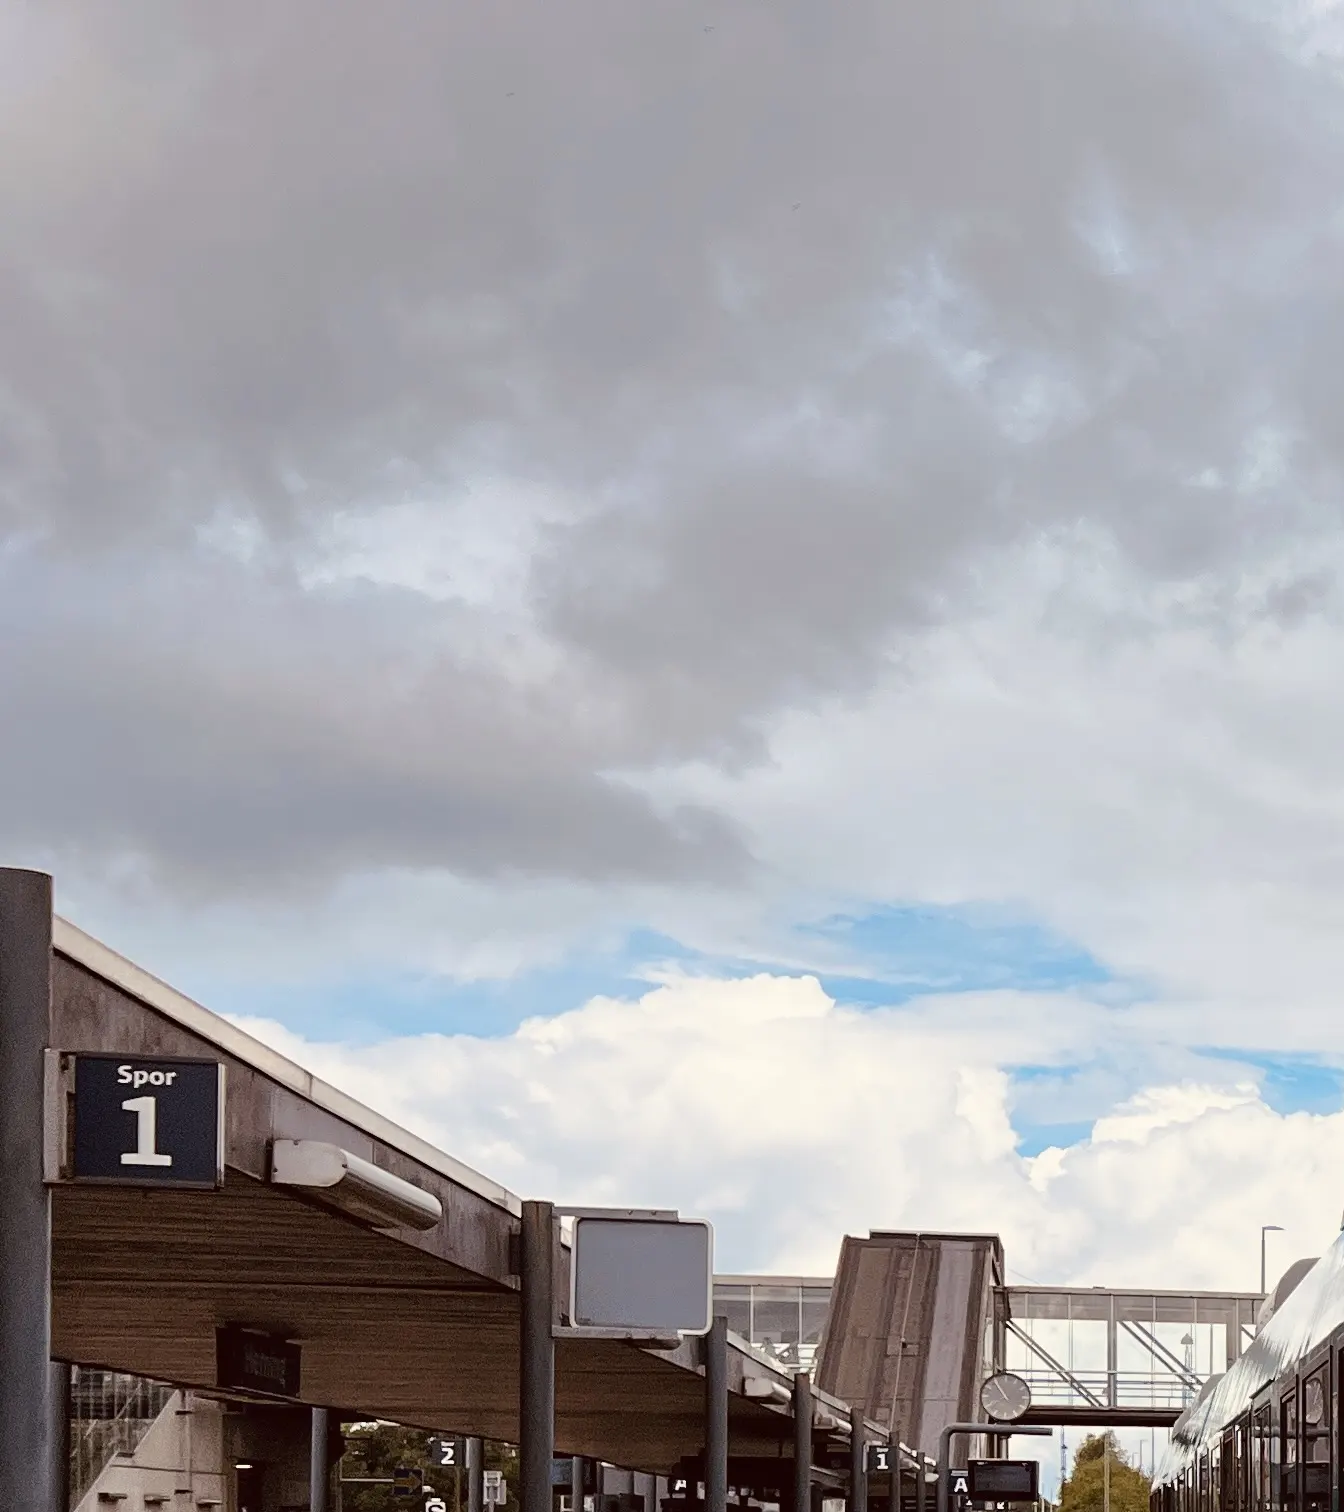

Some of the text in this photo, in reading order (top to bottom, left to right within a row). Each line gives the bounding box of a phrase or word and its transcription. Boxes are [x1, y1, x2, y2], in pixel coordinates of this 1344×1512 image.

[117, 1065, 178, 1089] Spor
[120, 1096, 173, 1167] 1
[441, 1447, 455, 1465] 2
[876, 1453, 889, 1470] 1
[954, 1477, 968, 1493] A
